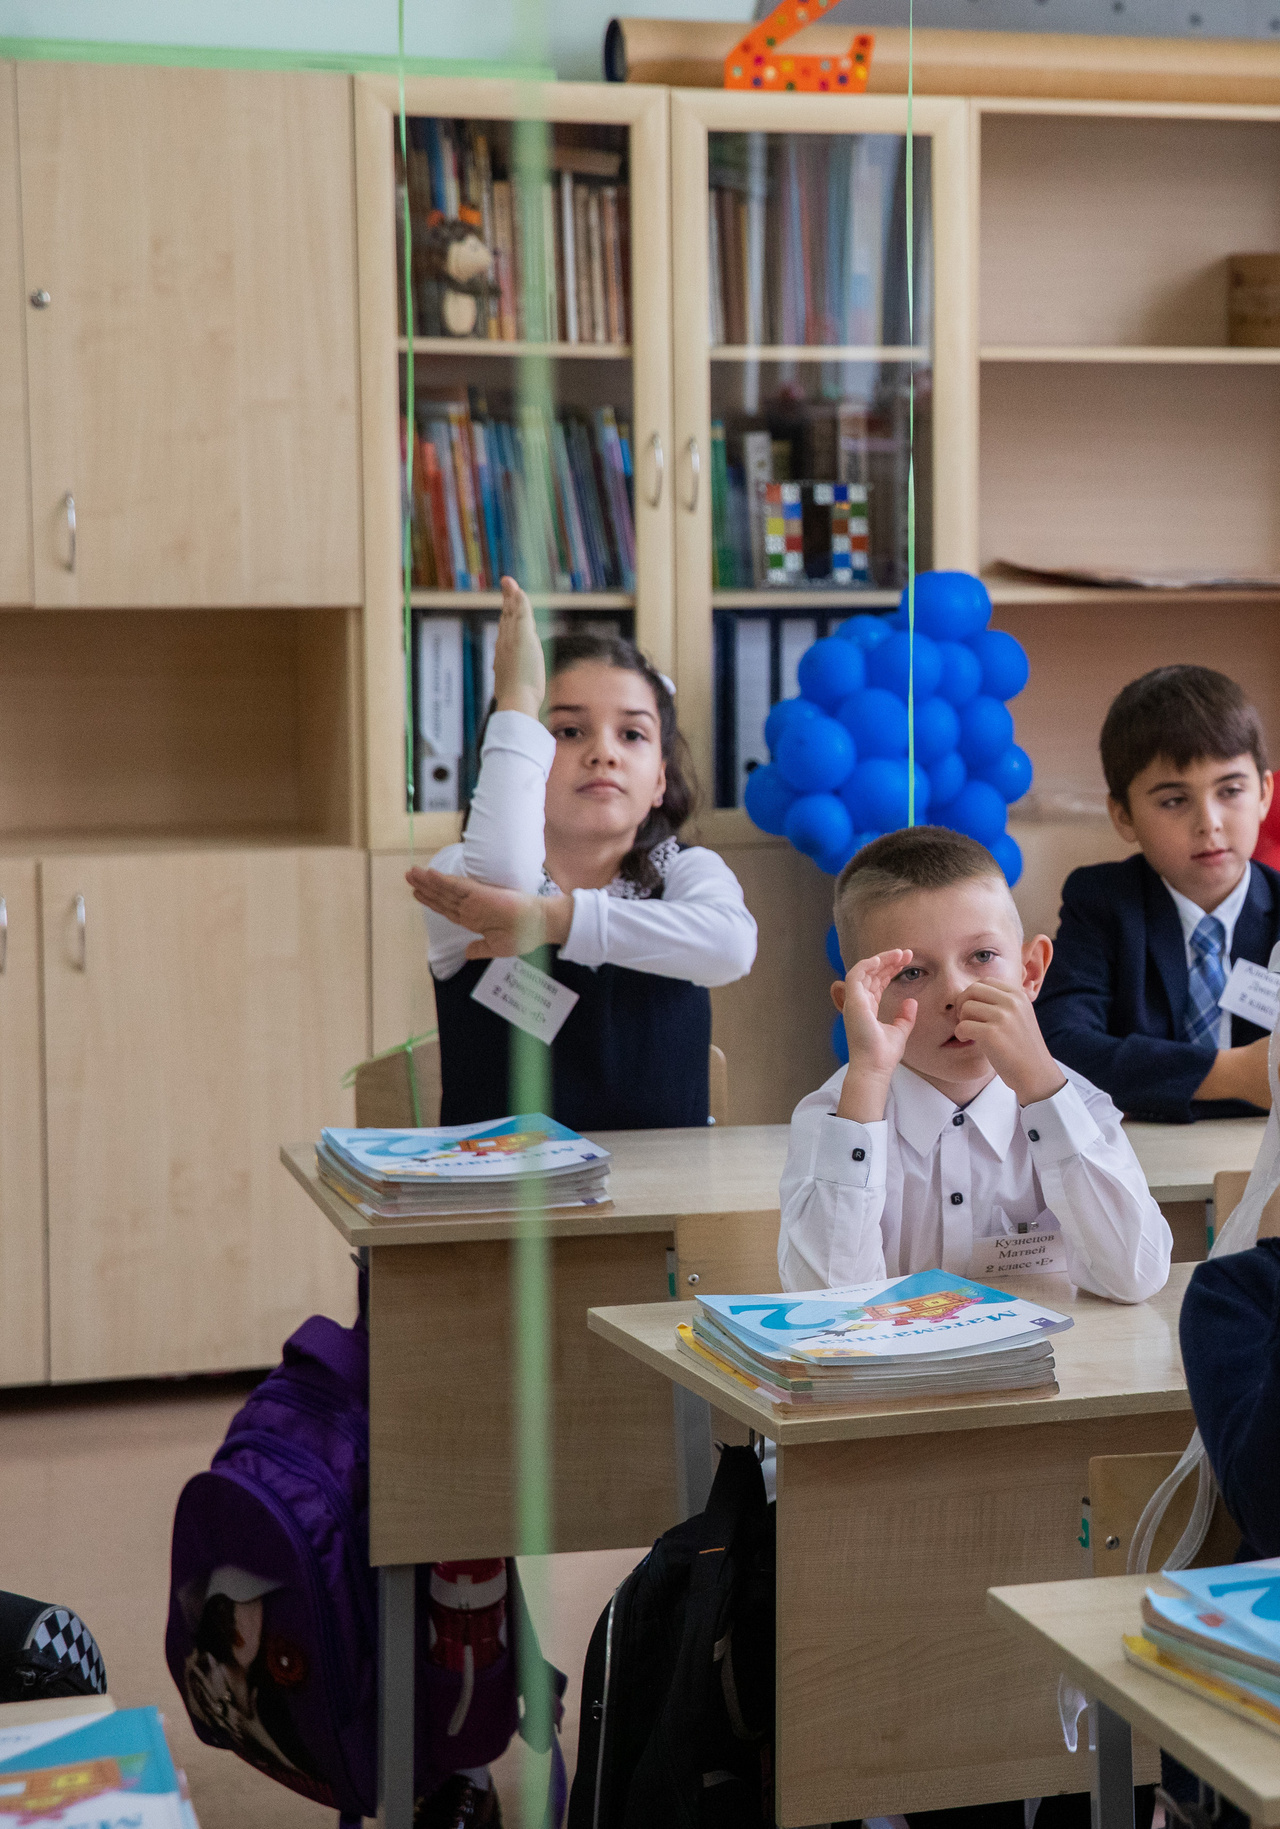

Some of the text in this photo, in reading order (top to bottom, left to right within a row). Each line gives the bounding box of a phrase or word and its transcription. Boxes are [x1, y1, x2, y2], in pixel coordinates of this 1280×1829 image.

[492, 984, 502, 996] 2
[1239, 991, 1248, 1003] 2
[995, 1234, 1055, 1249] Кузнецов
[998, 1246, 1046, 1259] Матвей
[985, 1264, 994, 1273] 2
[997, 1261, 1032, 1272] класс
[728, 1302, 836, 1330] 2
[818, 1309, 1019, 1344] Математика
